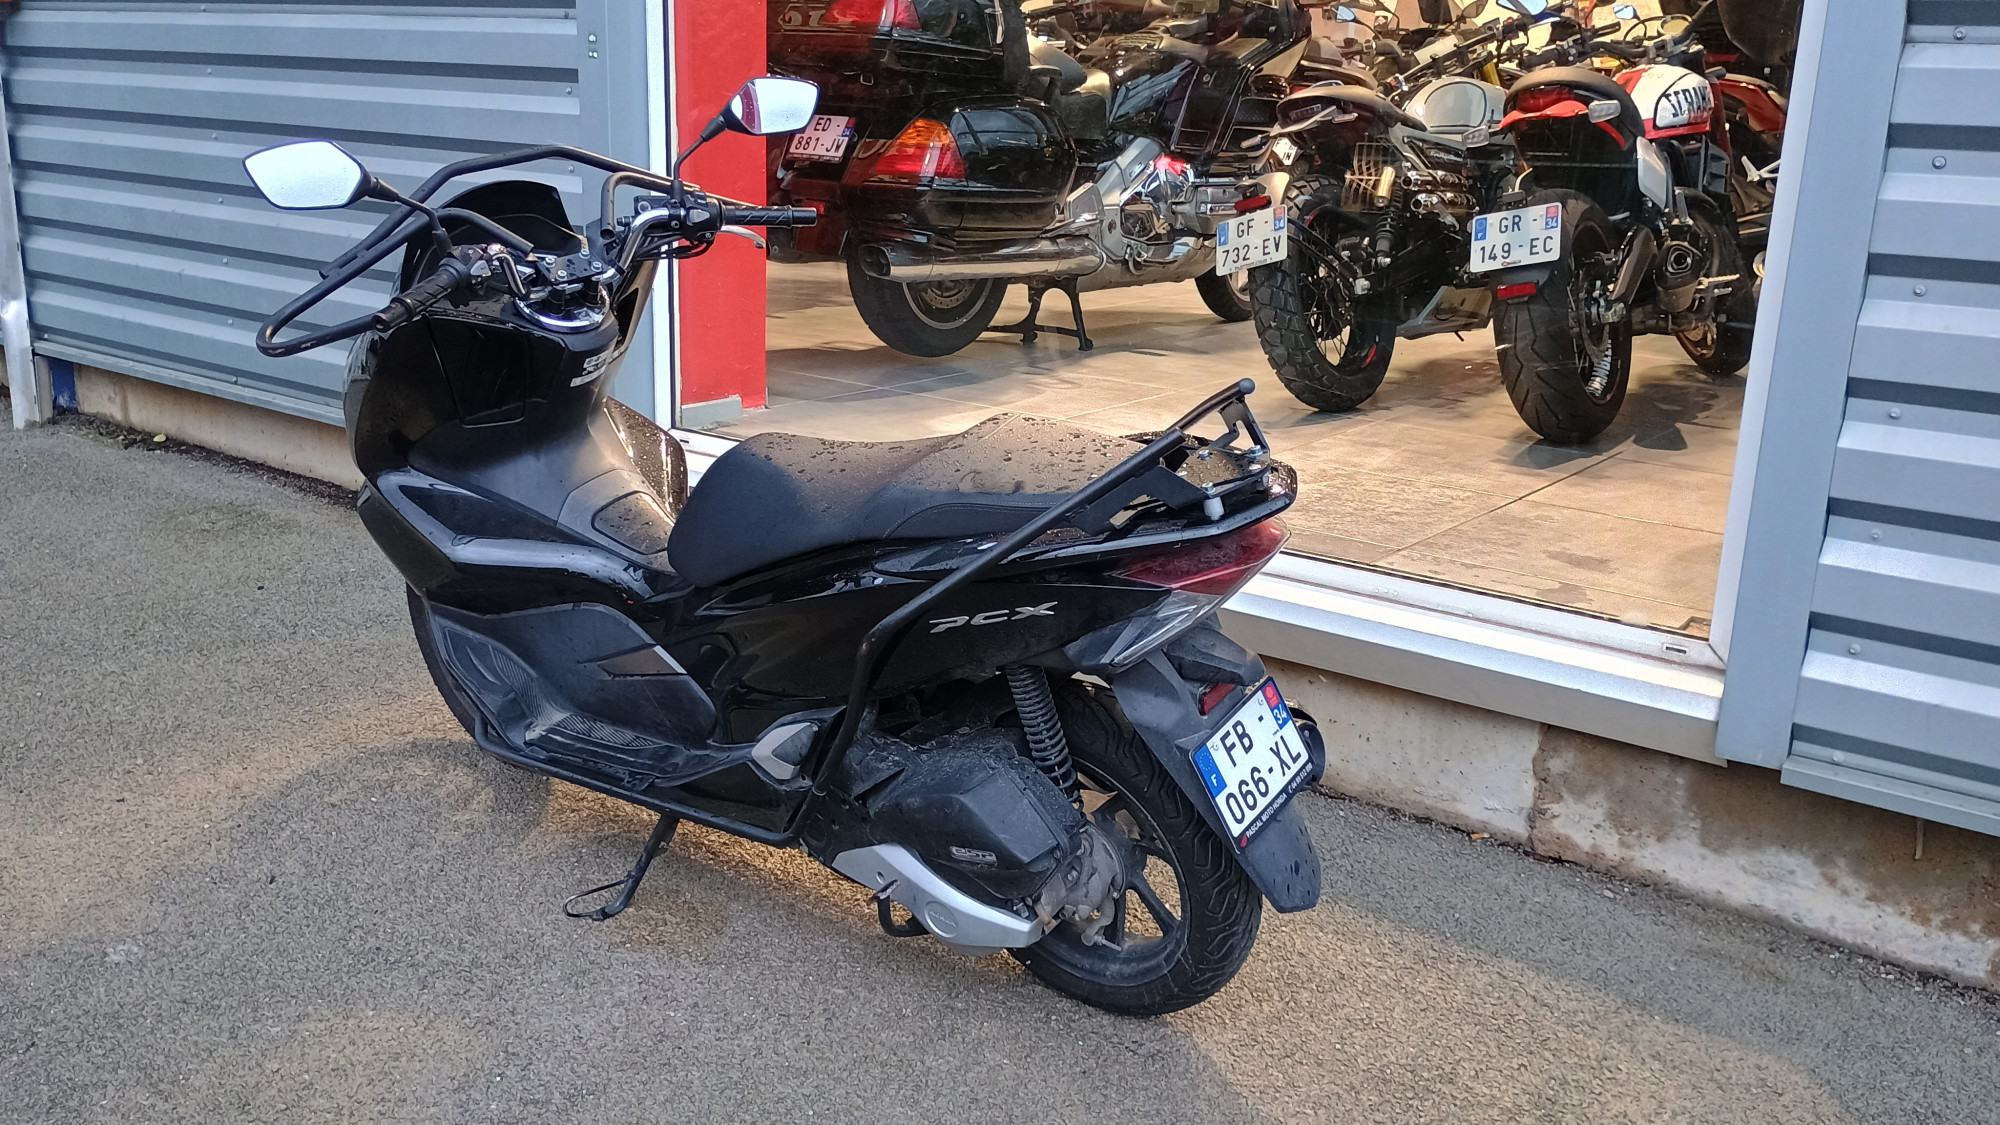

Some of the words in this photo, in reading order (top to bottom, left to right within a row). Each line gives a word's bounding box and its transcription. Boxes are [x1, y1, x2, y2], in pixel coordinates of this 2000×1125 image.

[794, 135, 845, 154] 881-JW
[1274, 219, 1285, 230] 34
[1546, 217, 1557, 228] 34
[1222, 235, 1281, 267] 732-EV
[929, 601, 1058, 633] PCX
[1273, 704, 1287, 724] 34
[1211, 774, 1218, 787] F
[1225, 735, 1302, 825] 066-XL
[1246, 819, 1263, 838] PASCAL
[1261, 806, 1274, 822] MOTO
[1272, 792, 1287, 810] HONDA
